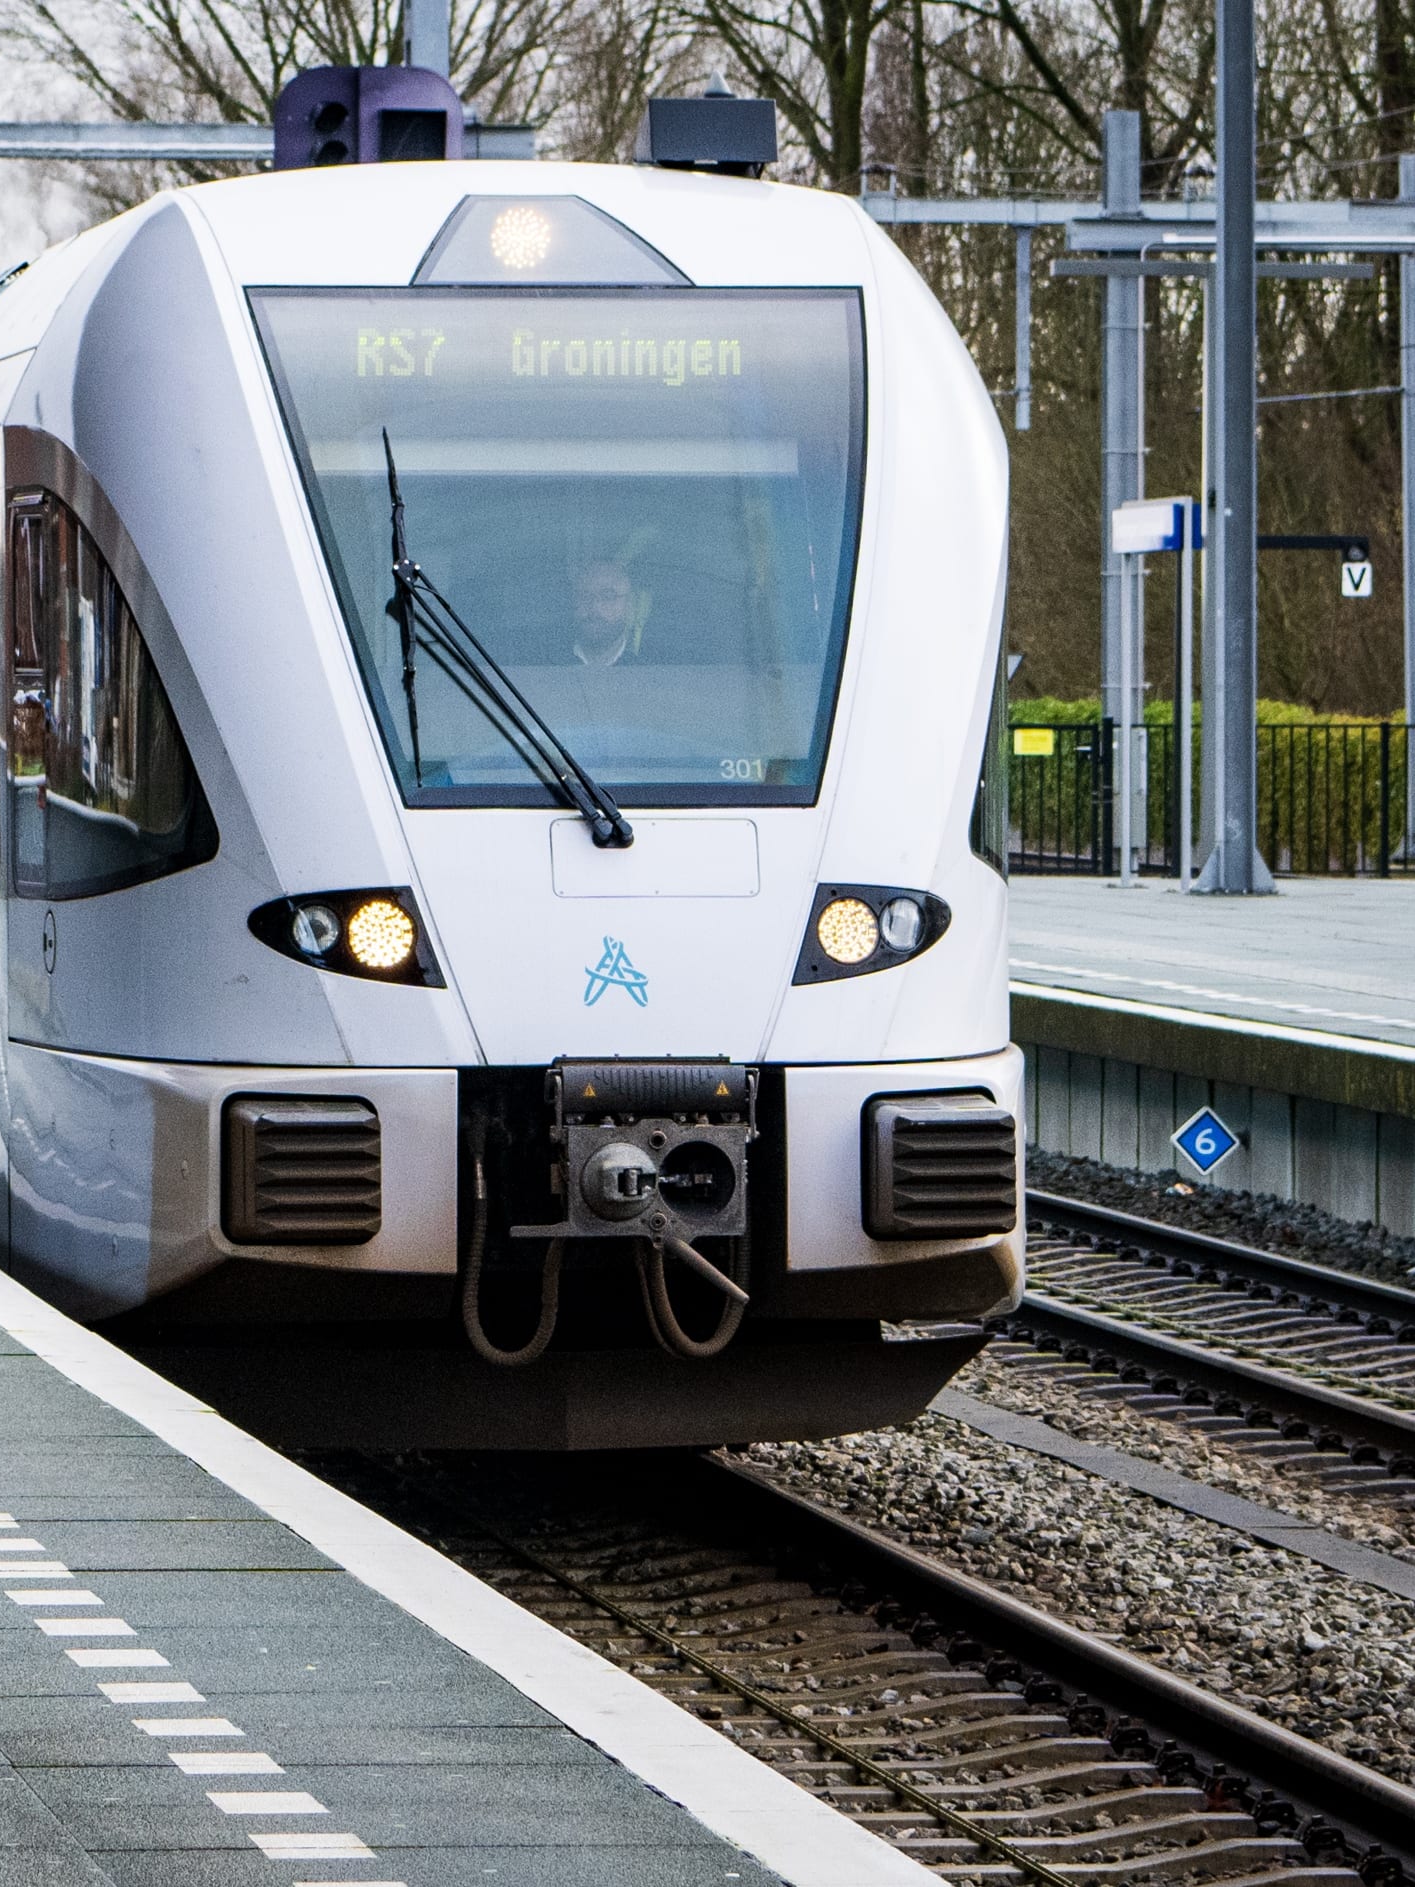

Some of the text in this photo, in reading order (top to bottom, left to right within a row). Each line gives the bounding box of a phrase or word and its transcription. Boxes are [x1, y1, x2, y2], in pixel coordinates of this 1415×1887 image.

[357, 327, 742, 386] RS7 Groningen
[1347, 567, 1367, 592] V
[720, 759, 762, 779] 301
[1195, 1128, 1216, 1155] 6
